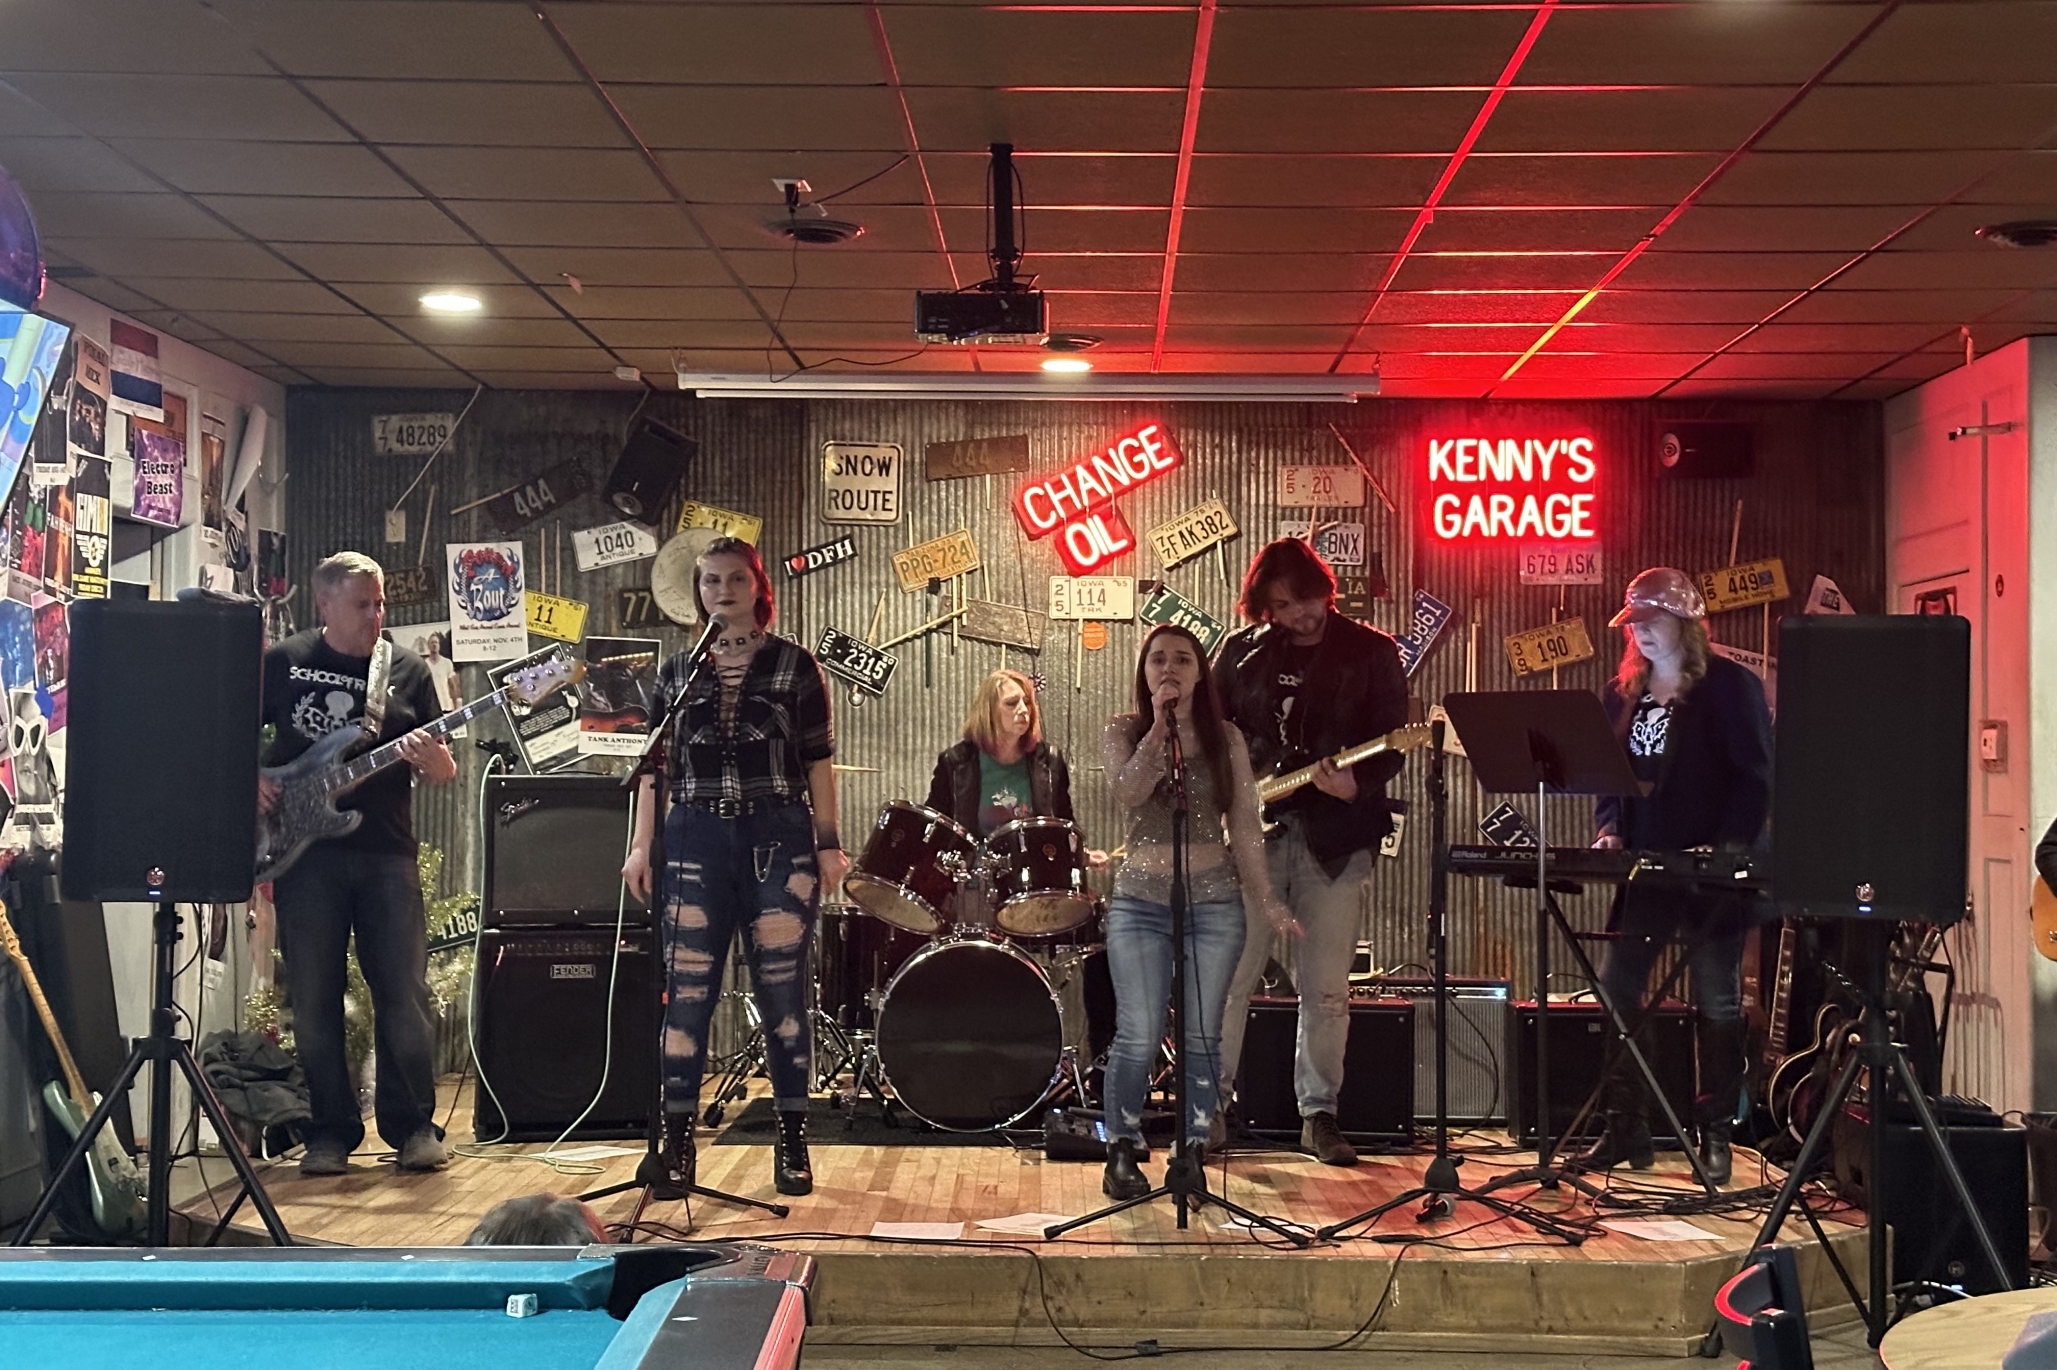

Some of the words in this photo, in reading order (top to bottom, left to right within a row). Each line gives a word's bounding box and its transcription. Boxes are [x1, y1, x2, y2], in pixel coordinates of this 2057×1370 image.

[396, 423, 447, 447] 48289
[142, 460, 175, 475] Electro
[831, 454, 892, 478] SNOW
[1428, 437, 1596, 483] KENNY'S
[147, 481, 173, 495] Beast
[1023, 425, 1174, 529] CHANGE
[1312, 475, 1332, 495] 20
[513, 477, 556, 518] 444
[827, 488, 893, 512] ROUTE
[708, 508, 734, 522] IOWA
[1164, 516, 1191, 533] IOWA
[1434, 493, 1595, 539] GARAGE
[599, 523, 627, 535] IOWA
[1167, 510, 1229, 556] FAK382
[594, 530, 635, 556] 1040
[1065, 514, 1128, 567] OIL
[1328, 532, 1360, 557] BNX
[600, 548, 636, 561] ANTIQUE
[806, 538, 854, 569] DFH
[899, 540, 970, 582] PPG-724
[1527, 554, 1557, 575] 679
[1565, 553, 1596, 575] ASK
[1726, 566, 1755, 578] IOWA
[1728, 573, 1759, 596] 449
[532, 594, 561, 607] IOWA
[1076, 588, 1106, 606] 114
[1177, 598, 1203, 618] IOWA
[534, 604, 555, 625] 11
[1524, 629, 1551, 642] IOWA
[847, 638, 873, 656] IOWA
[1537, 635, 1569, 663] 190
[825, 657, 873, 685] COMMERCIAL
[843, 648, 887, 680] 2315
[588, 735, 609, 743] TANK
[610, 736, 647, 745] ANTHONY
[1462, 851, 1487, 859] Roland
[1495, 851, 1556, 860] JUNO-S
